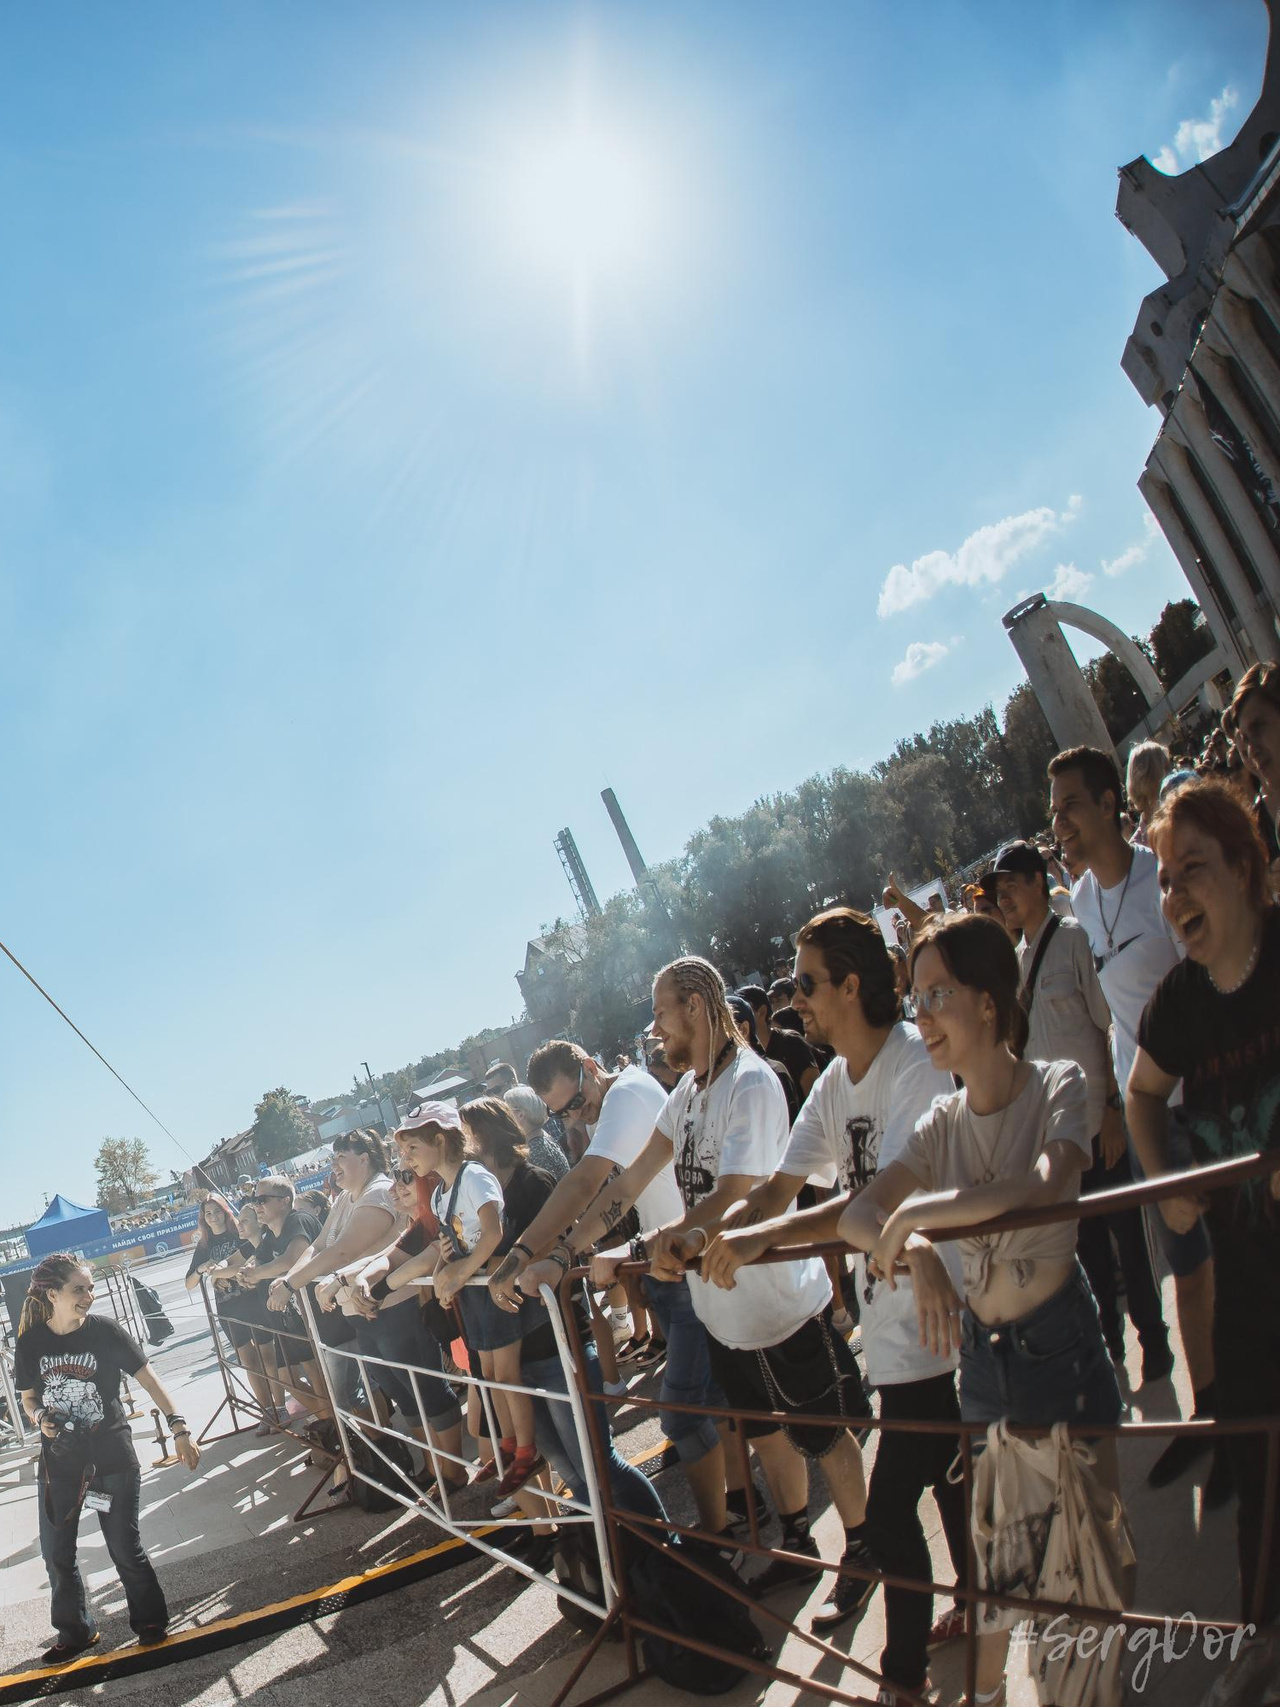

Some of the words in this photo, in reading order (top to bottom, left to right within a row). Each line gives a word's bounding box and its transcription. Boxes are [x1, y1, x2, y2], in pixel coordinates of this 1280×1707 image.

[112, 1237, 136, 1249] НАЙДИ
[137, 1231, 155, 1243] СВОЕ
[157, 1220, 198, 1237] ПРИЗВАНИЕ!
